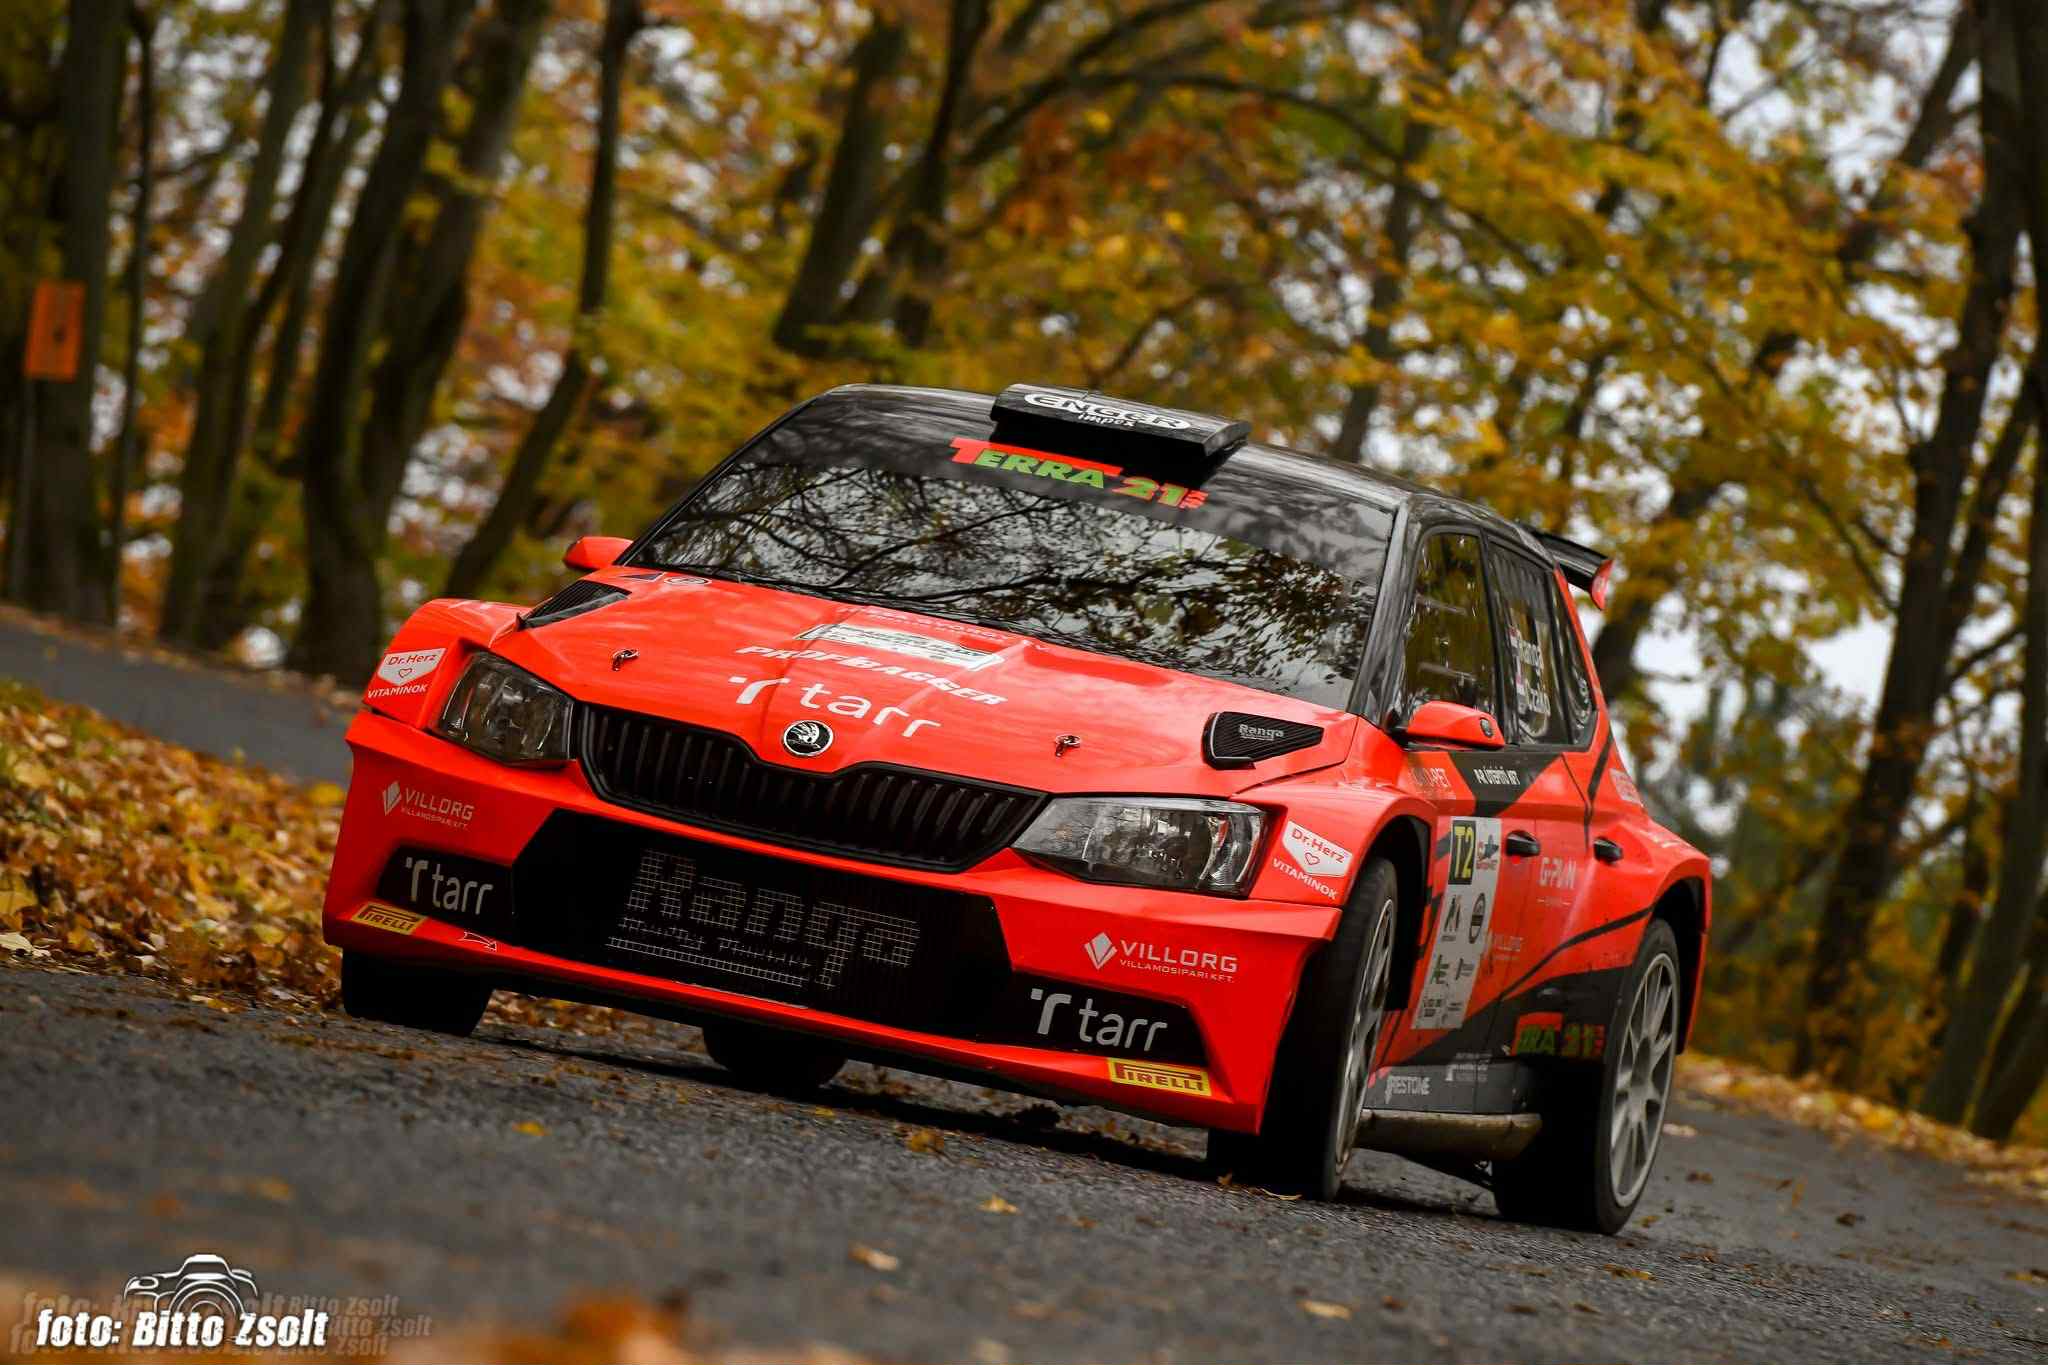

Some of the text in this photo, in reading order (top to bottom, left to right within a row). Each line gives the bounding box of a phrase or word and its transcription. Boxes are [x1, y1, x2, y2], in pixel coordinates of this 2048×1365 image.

[950, 437, 1123, 488] TERRA
[388, 653, 437, 666] Dr.Herz
[368, 683, 429, 699] VITAMINOK
[799, 683, 942, 738] tarr
[1238, 723, 1285, 739] Ranga
[404, 786, 476, 822] VILLORG
[1291, 827, 1346, 864] Dr.Herz
[431, 863, 495, 915] tarr
[1272, 857, 1338, 900] VITAMINOK
[358, 904, 422, 931] PIRELLI
[1120, 939, 1238, 974] VILLORG
[1078, 998, 1168, 1052] tarr
[1111, 1061, 1205, 1091] PIRELLI
